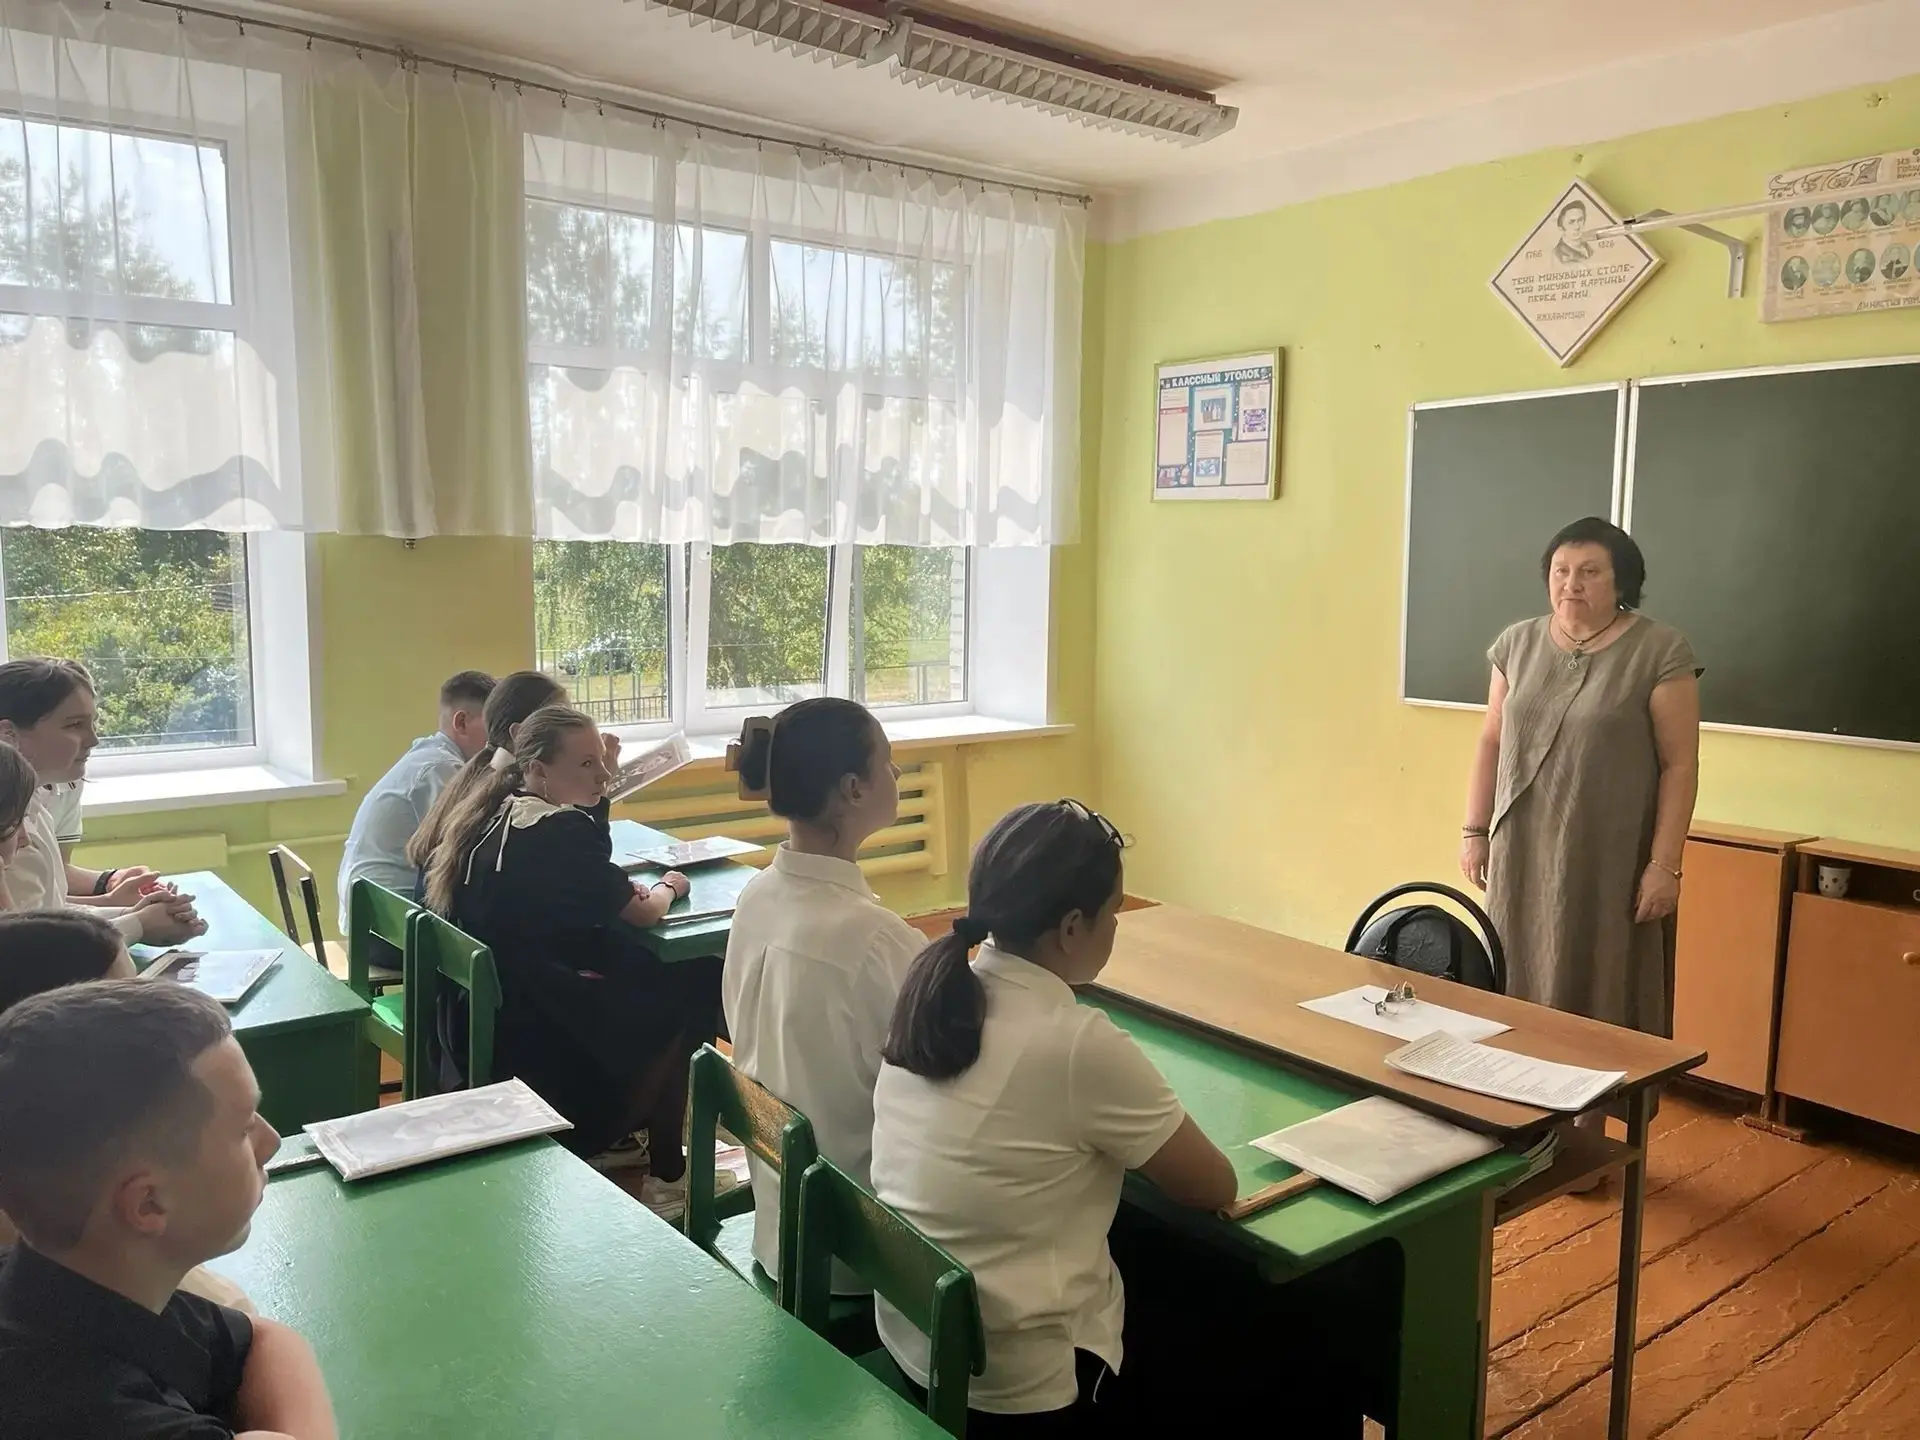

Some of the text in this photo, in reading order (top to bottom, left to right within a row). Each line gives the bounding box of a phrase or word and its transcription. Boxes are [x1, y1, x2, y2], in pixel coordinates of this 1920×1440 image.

[1512, 276, 1535, 286] ТЕНИ
[1538, 270, 1593, 282] МИНУВШИХ
[1538, 281, 1577, 292] РИСУЮТ
[1581, 275, 1626, 287] КАРТИНЫ
[1528, 293, 1557, 303] ПЕРЕД
[1172, 368, 1260, 387] КЛАССНЫЙ УГОЛОК
